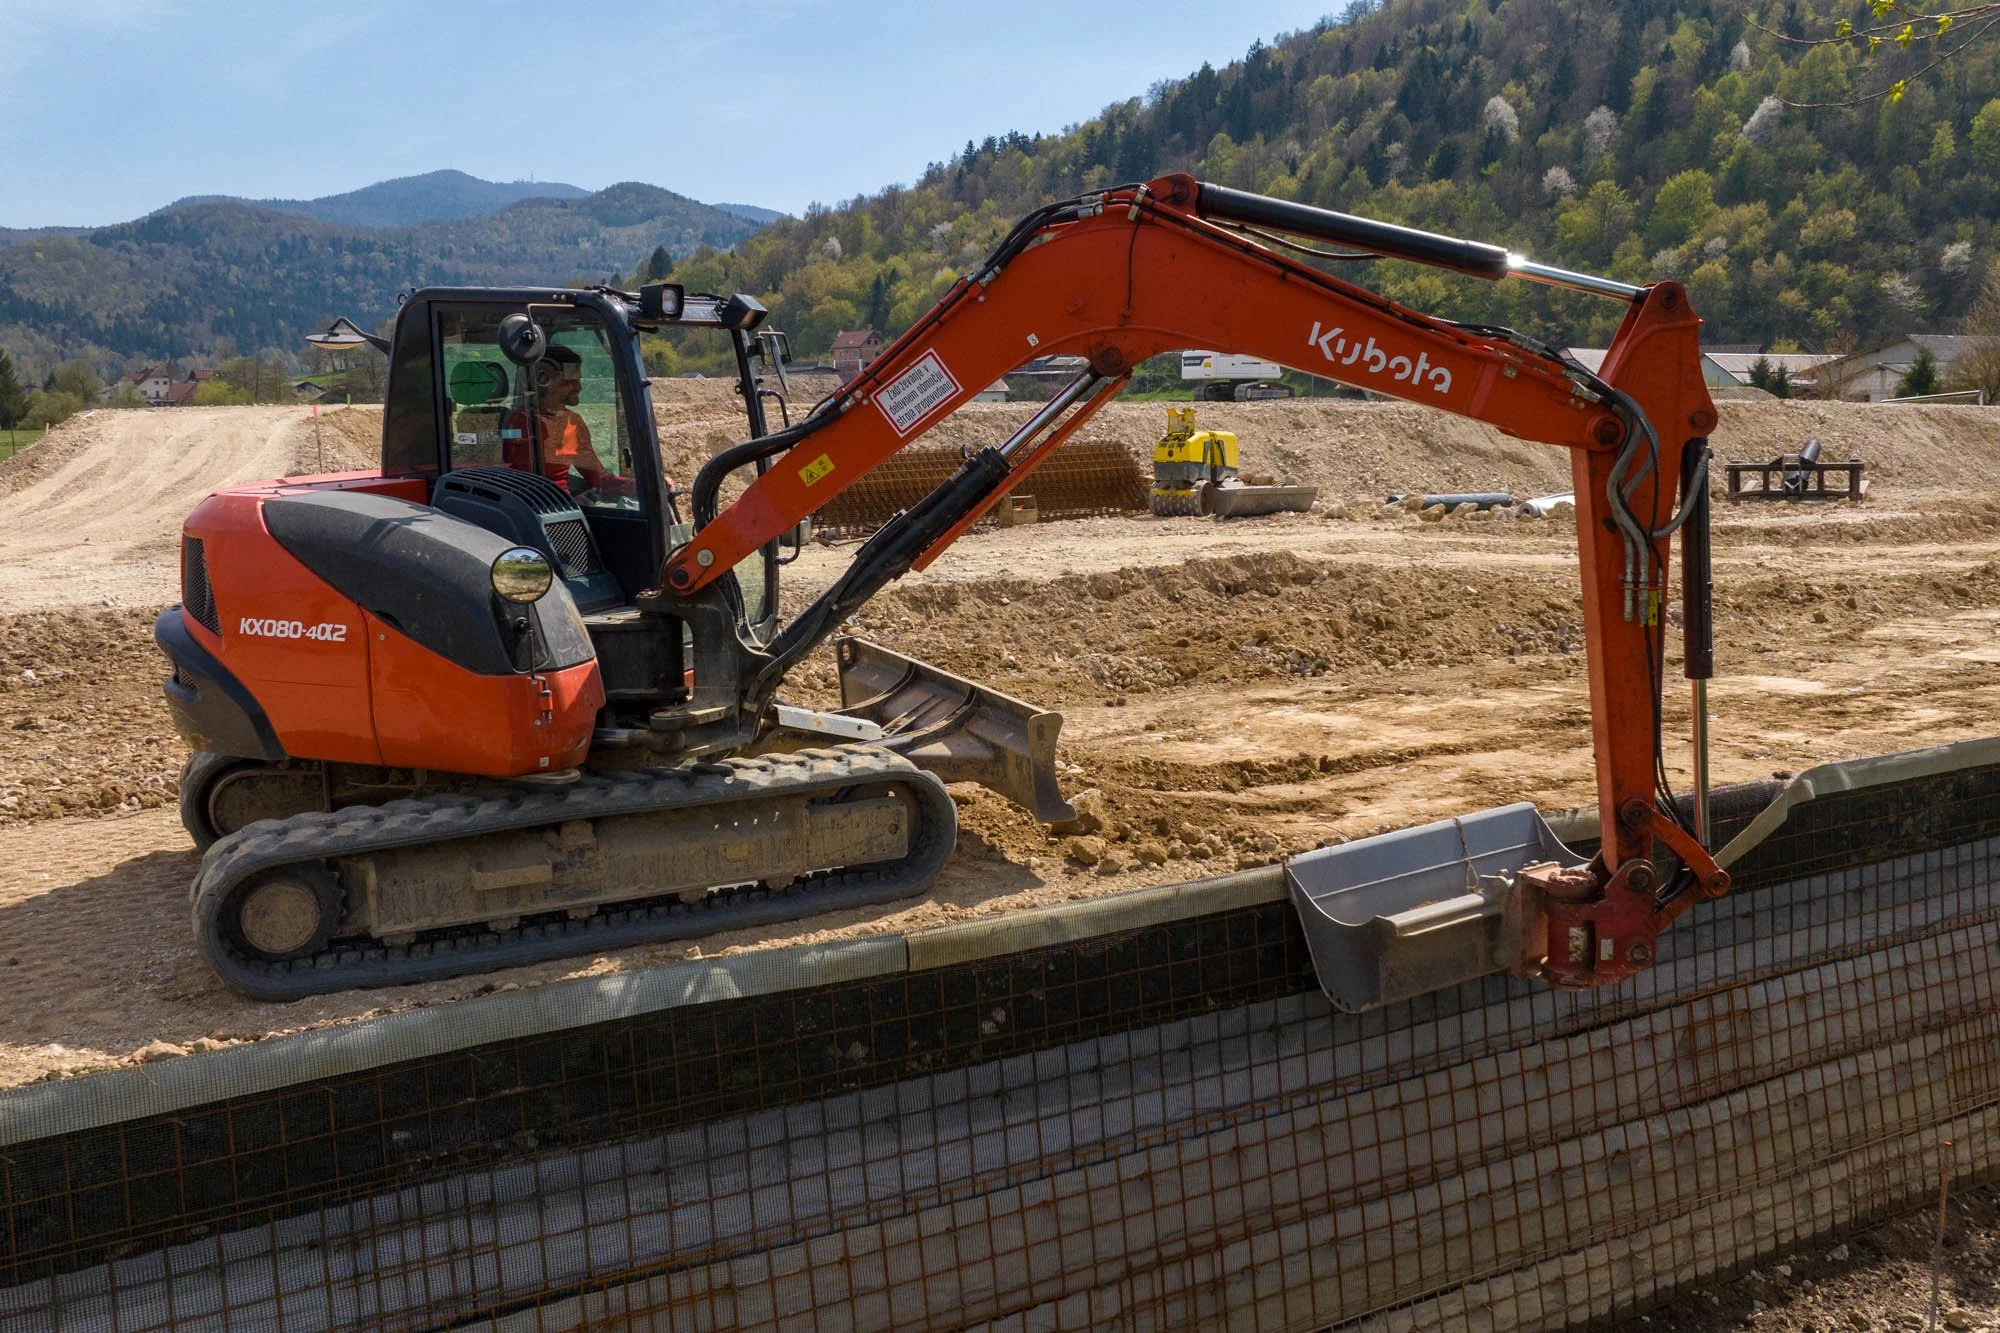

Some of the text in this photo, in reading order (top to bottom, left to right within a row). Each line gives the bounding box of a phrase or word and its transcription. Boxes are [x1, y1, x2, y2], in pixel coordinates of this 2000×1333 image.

[1308, 321, 1452, 394] Kubota
[886, 368, 925, 400] Zadrževanje
[888, 370, 944, 415] delovnem območju
[896, 381, 953, 427] stroja prepovedano
